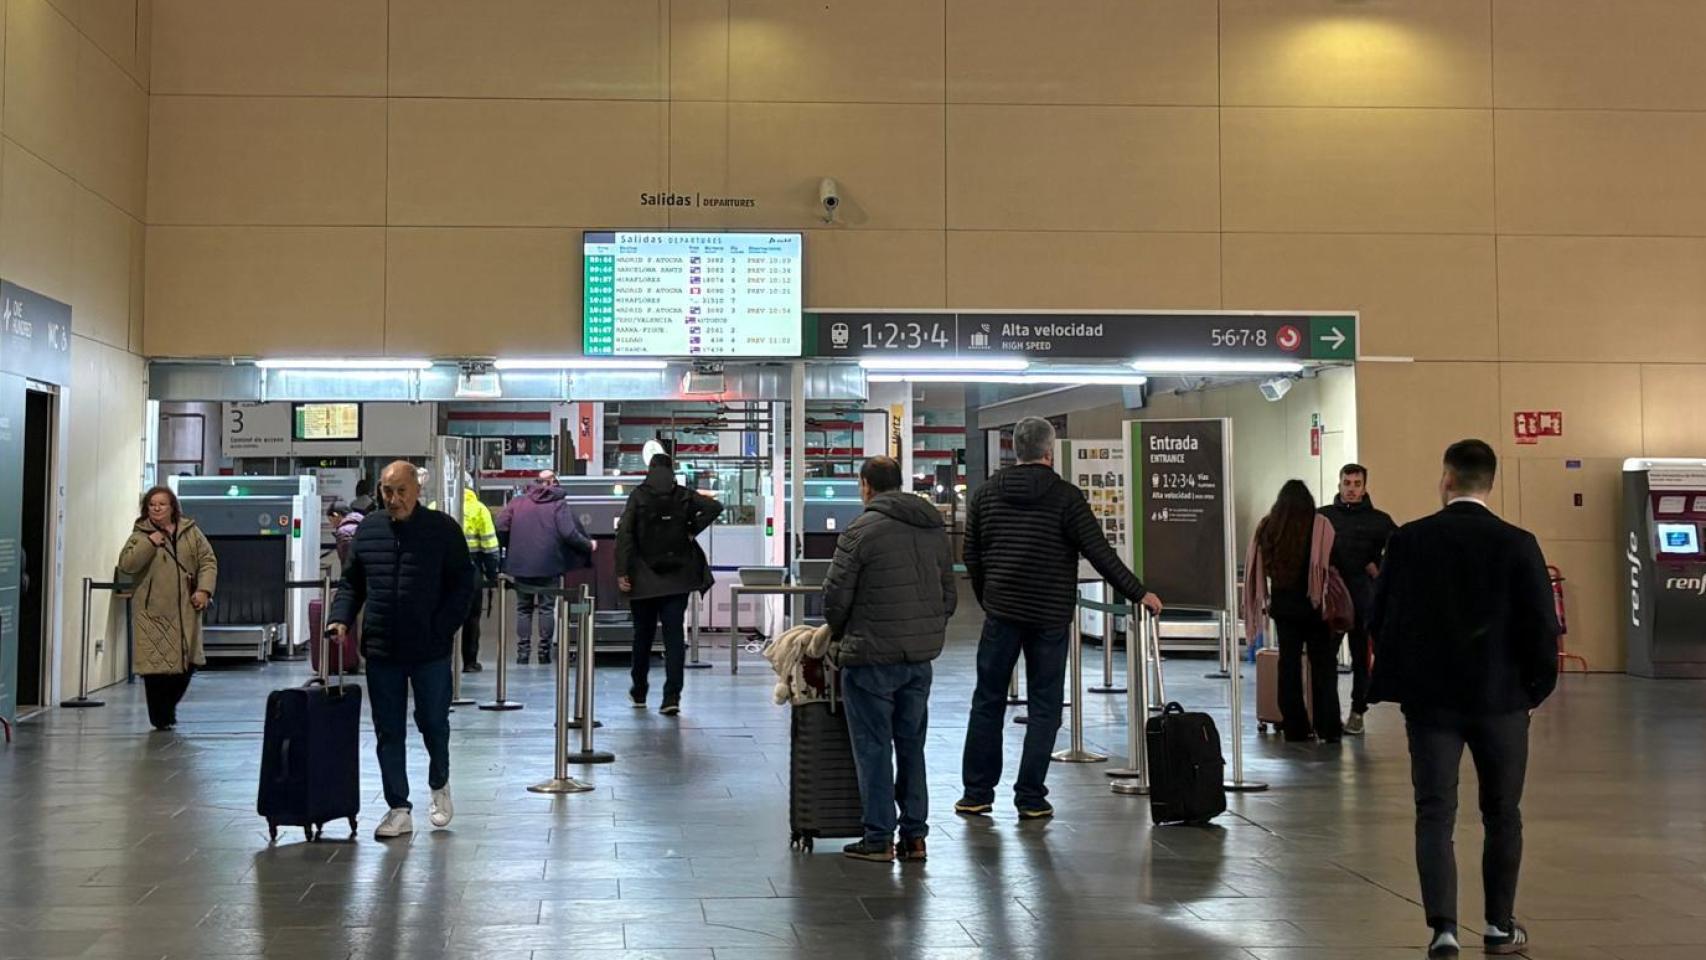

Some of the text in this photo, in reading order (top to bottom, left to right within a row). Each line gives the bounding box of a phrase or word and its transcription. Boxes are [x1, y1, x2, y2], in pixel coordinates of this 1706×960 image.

[640, 192, 755, 207] Salidas DEPARTURES
[621, 234, 662, 244] Salidas
[1001, 323, 1030, 337] Alta
[1033, 323, 1104, 338] velocidad
[1002, 341, 1052, 351] HIGH SPEED
[231, 410, 244, 434] 3
[1150, 434, 1199, 450] Entrada
[1150, 454, 1185, 464] ENTRANCE
[1152, 492, 1164, 500] Alta
[1164, 491, 1191, 500] velocidad
[1627, 531, 1642, 627] renfe
